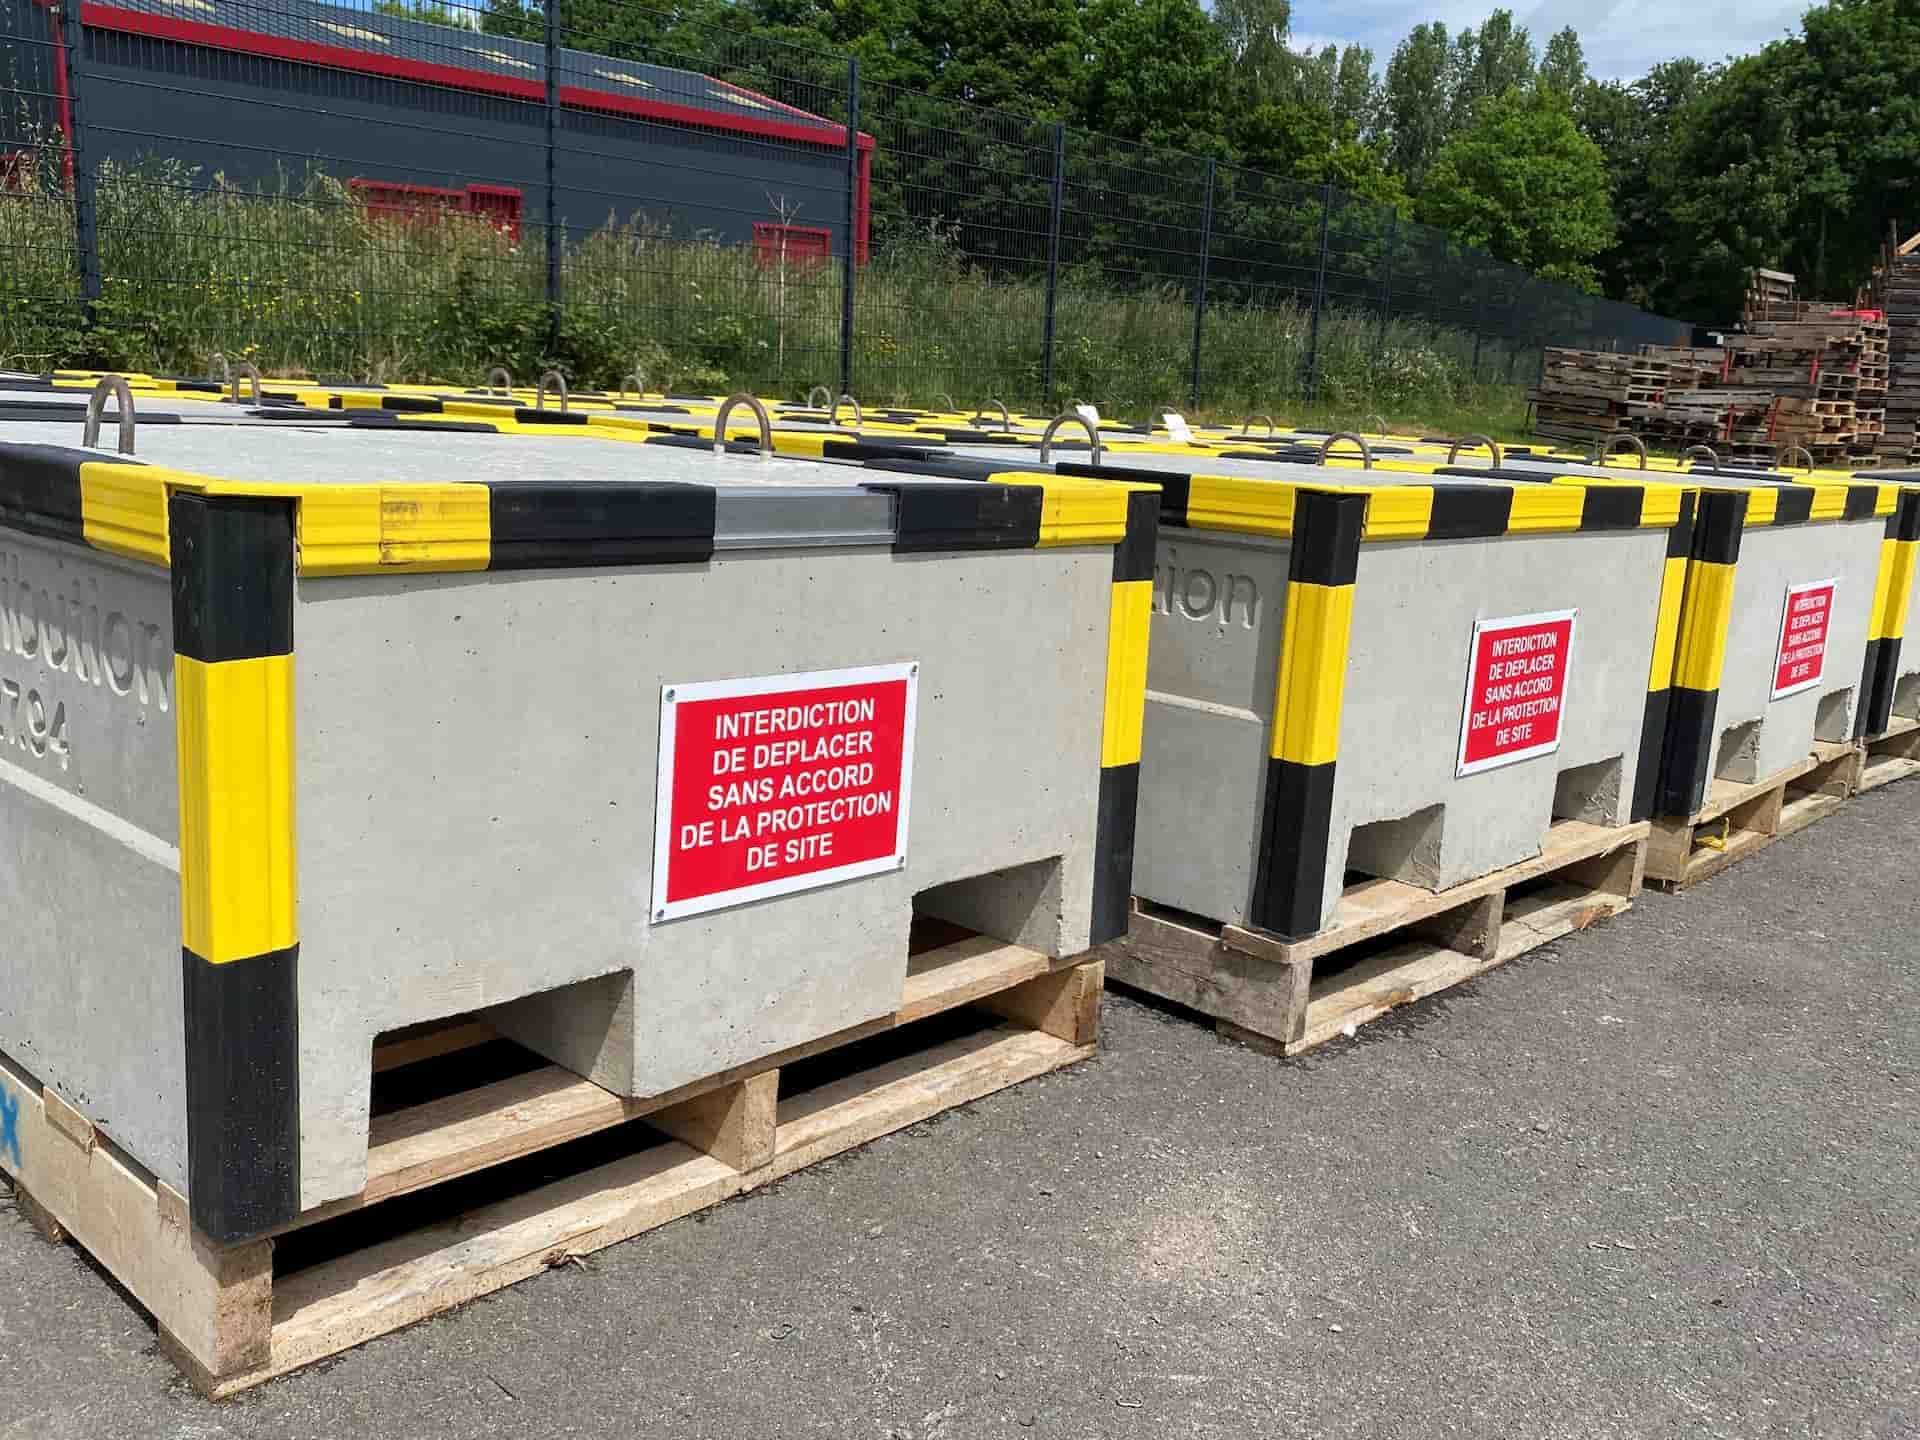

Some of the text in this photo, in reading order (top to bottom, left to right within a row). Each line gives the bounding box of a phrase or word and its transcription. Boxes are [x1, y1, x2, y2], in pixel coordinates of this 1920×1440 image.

[1491, 631, 1559, 657] INTERDICTION
[1489, 654, 1555, 681] DE DEPLACER
[1485, 676, 1553, 704] SANS ACCORD
[714, 697, 875, 740] INTERDICTION
[1472, 695, 1559, 730] DE LA PROTECTION
[712, 730, 873, 775] DE DEPLACER
[1496, 723, 1533, 746] DE SITE
[707, 762, 873, 811] SANS ACCORD
[680, 790, 892, 850] DE LA PROTECTION
[746, 832, 833, 871] DE SITE
